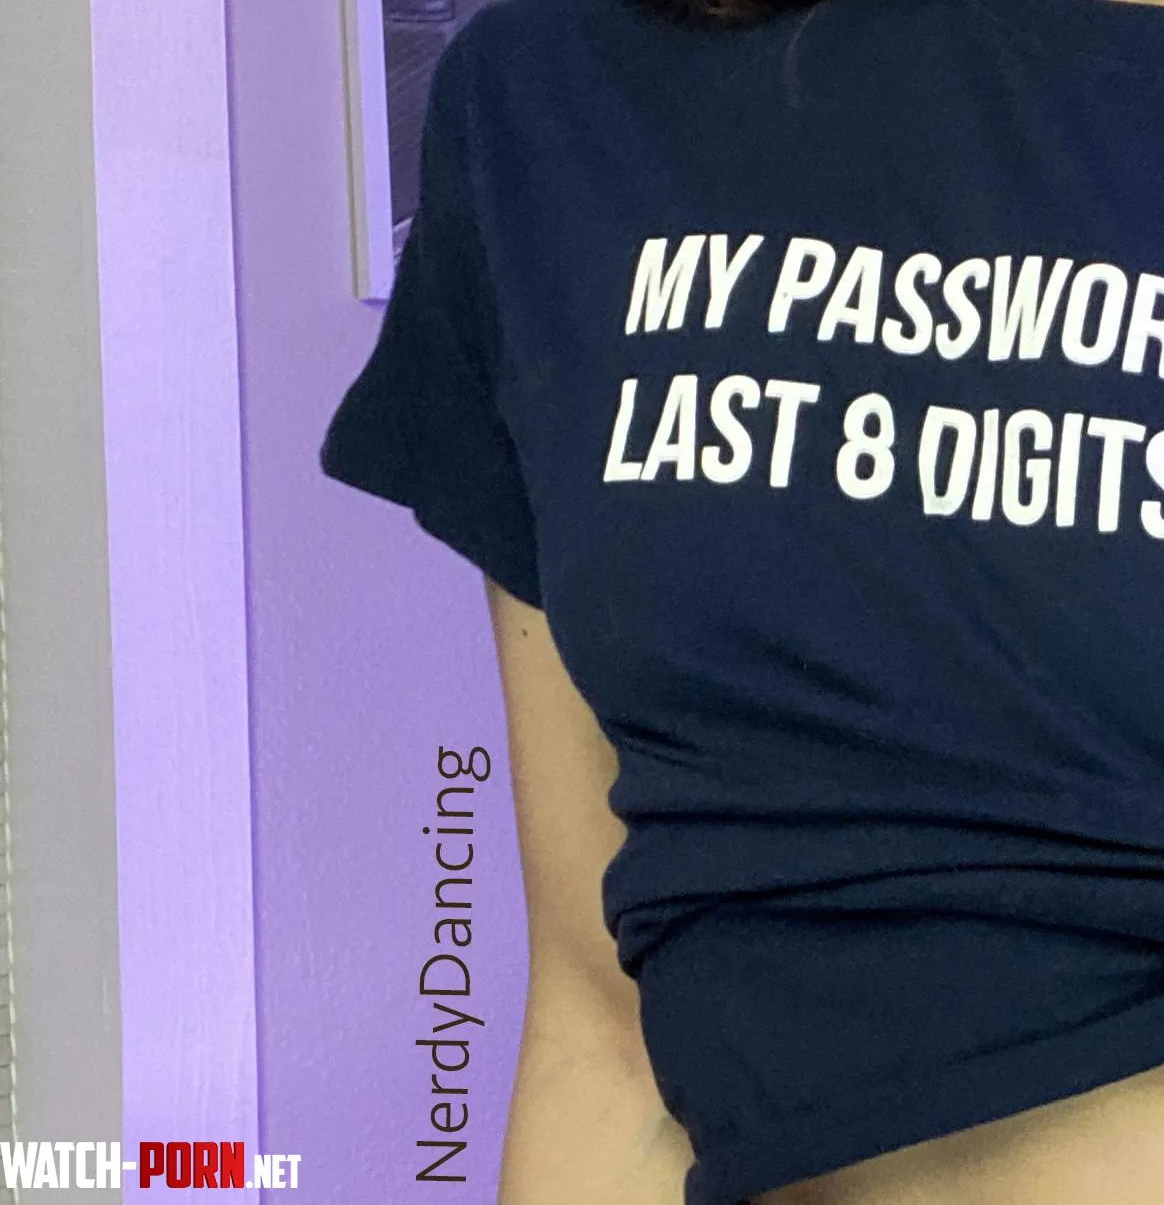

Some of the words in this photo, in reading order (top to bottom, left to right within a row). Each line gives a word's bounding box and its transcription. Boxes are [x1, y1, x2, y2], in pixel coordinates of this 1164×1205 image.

[625, 233, 765, 336] MY
[603, 374, 821, 488] LAST
[836, 392, 896, 500] 8
